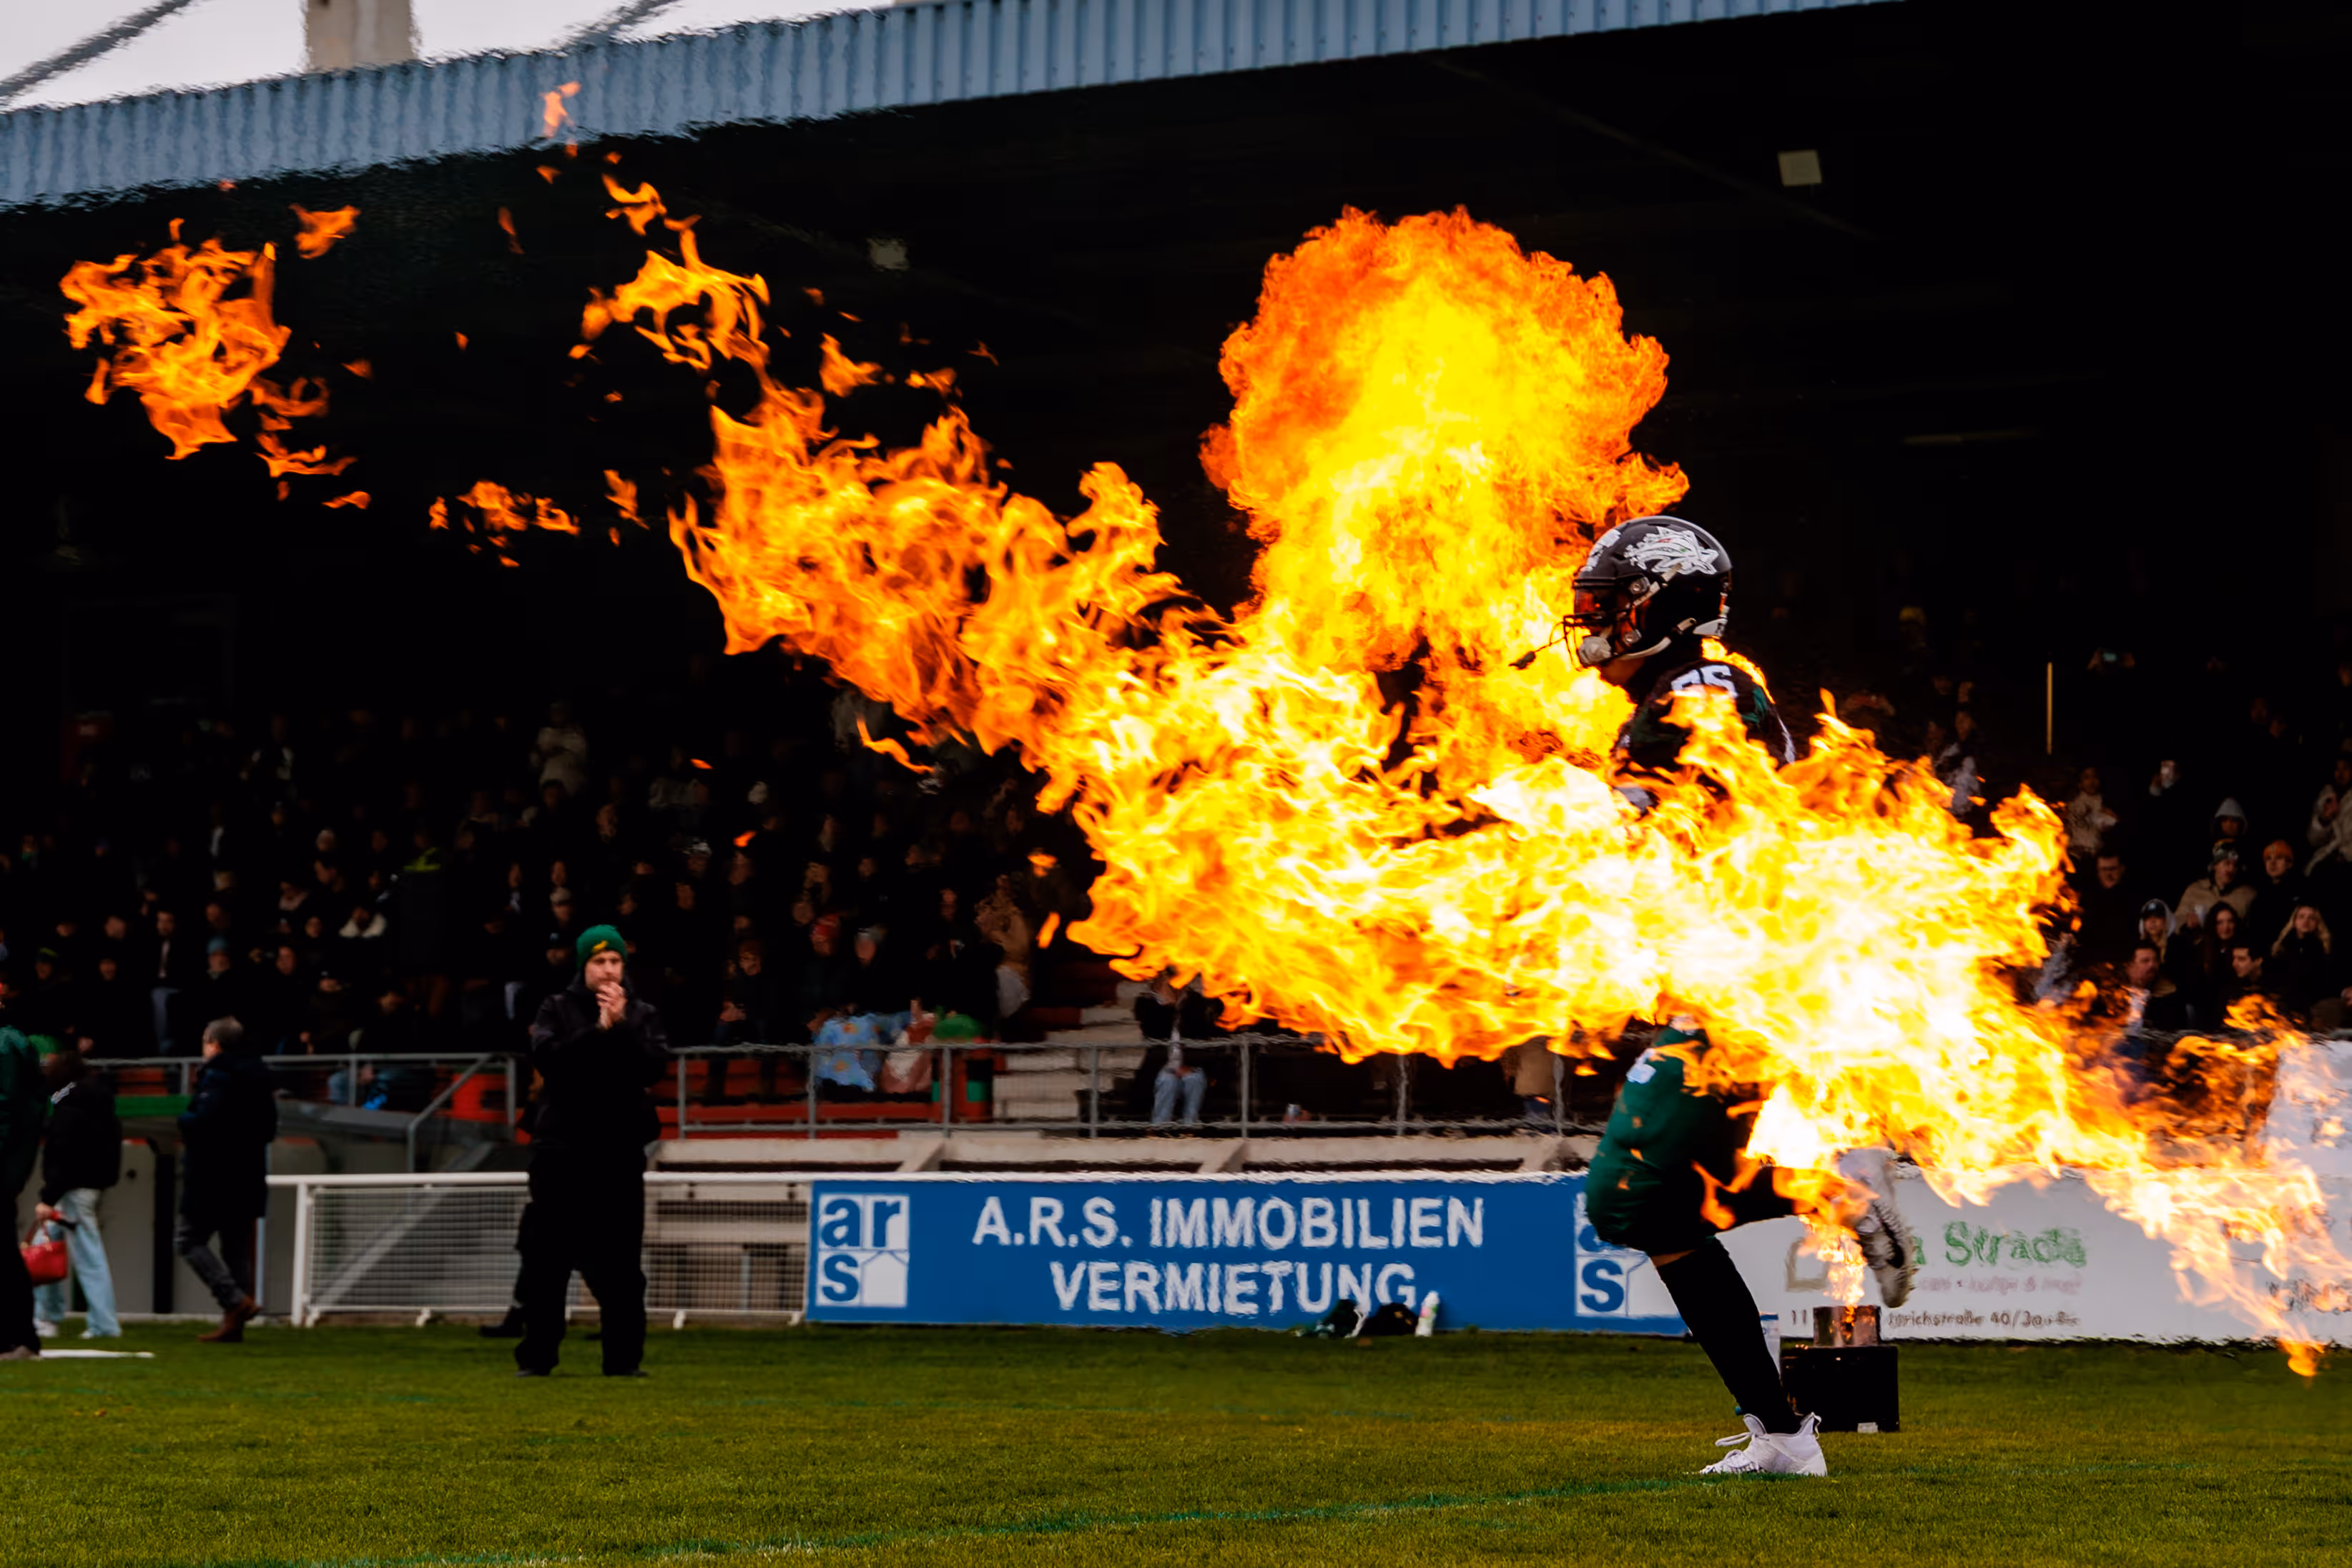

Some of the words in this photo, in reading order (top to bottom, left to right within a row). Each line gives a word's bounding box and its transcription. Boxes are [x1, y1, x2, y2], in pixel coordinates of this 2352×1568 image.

[822, 1198, 900, 1248] ar
[973, 1197, 1131, 1249] A.R.S.
[1150, 1197, 1482, 1250] IMMOBILIEN
[1050, 1261, 1415, 1318] VERMIETUNG
